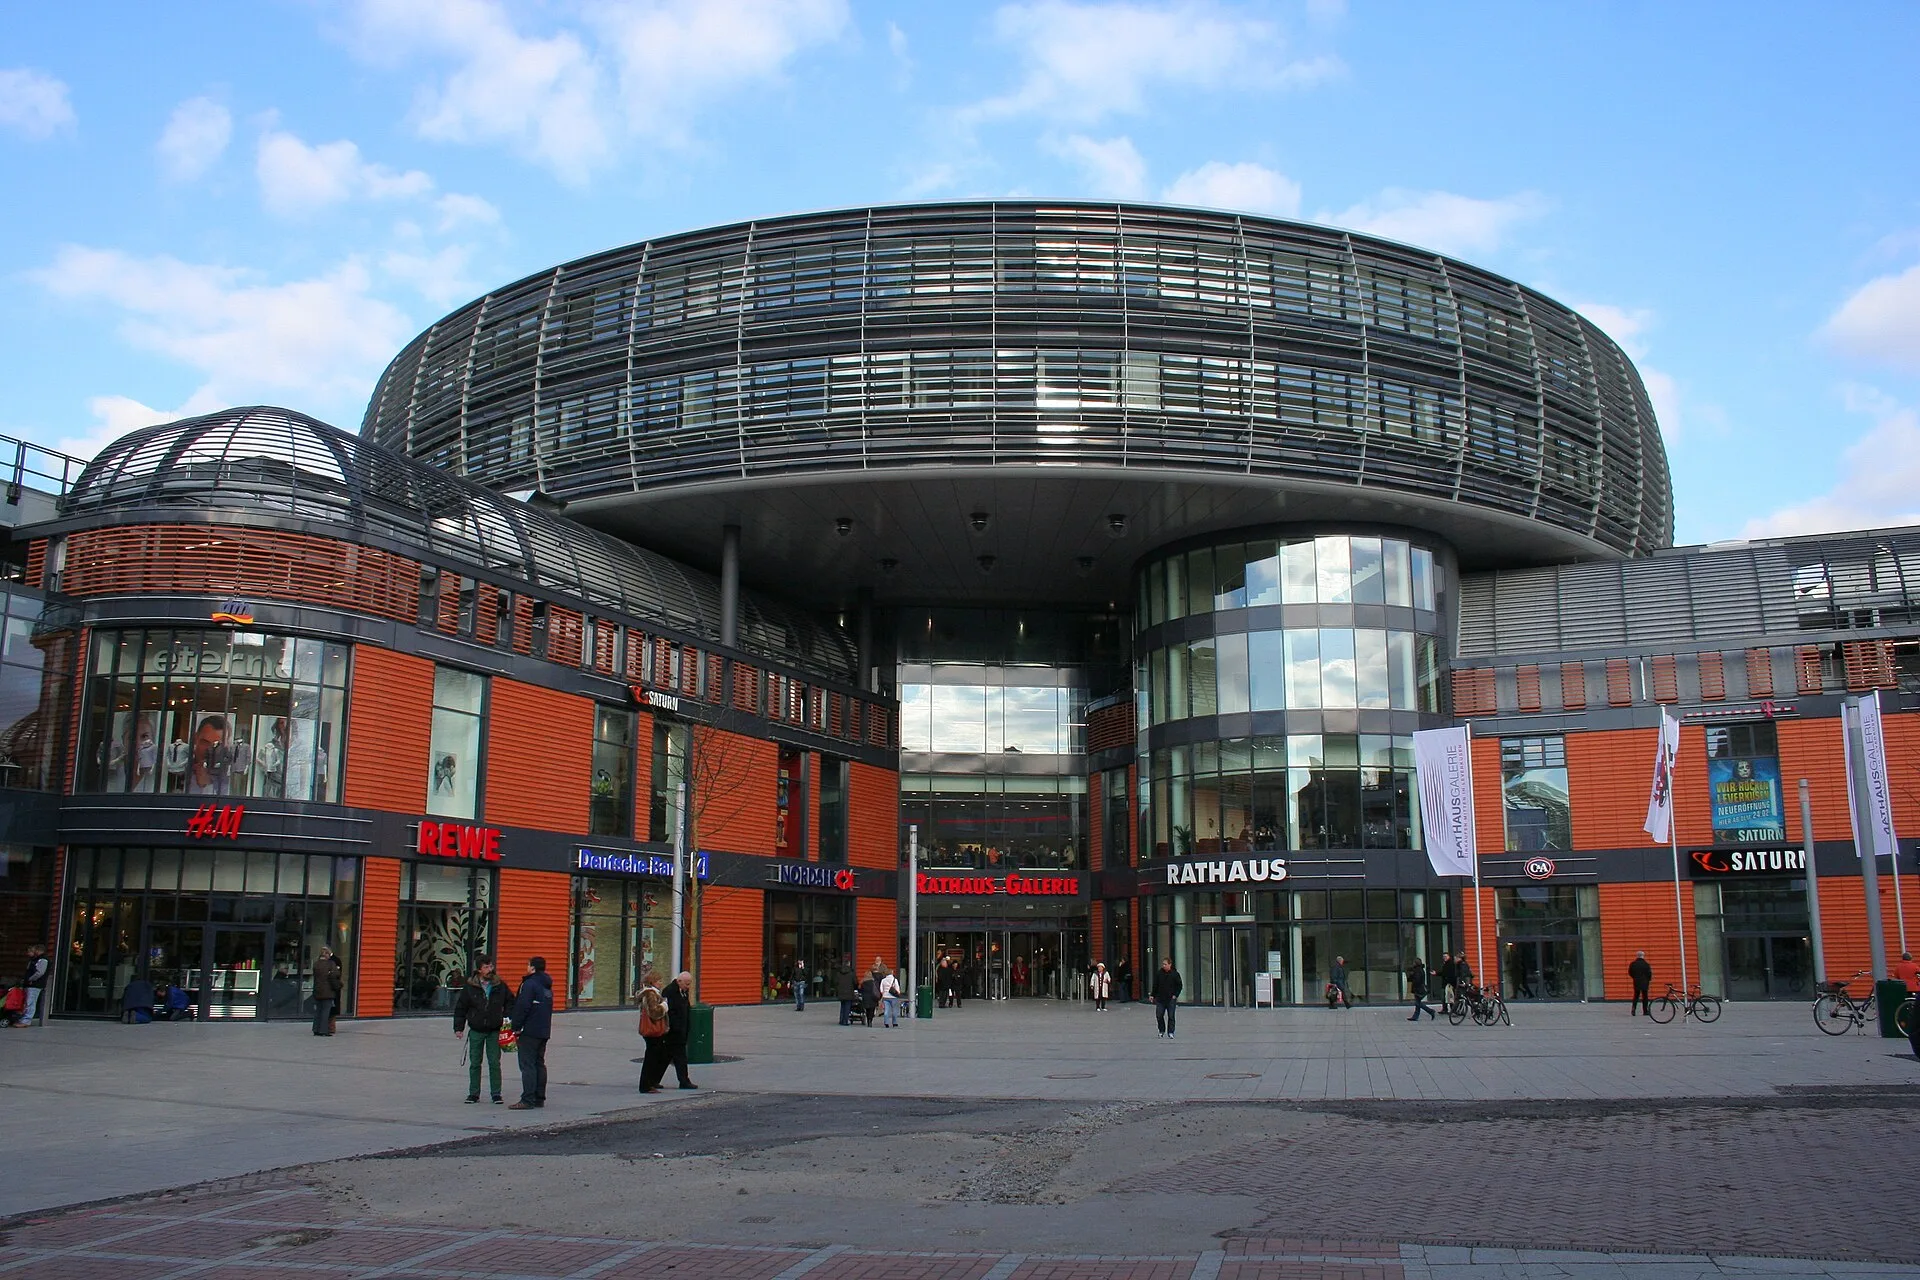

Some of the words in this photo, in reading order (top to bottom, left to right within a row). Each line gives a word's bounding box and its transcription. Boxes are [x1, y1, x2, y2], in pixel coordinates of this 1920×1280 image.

[218, 598, 251, 615] dm
[153, 646, 300, 680] eterna
[648, 690, 679, 711] SATURN
[1716, 782, 1736, 793] WIR
[1717, 791, 1770, 803] LEVERKUSEN
[1446, 745, 1465, 859] RATHAUSGALERIE
[185, 803, 245, 840] H&M
[416, 821, 501, 861] REWE
[1738, 828, 1785, 842] SATURN
[578, 849, 647, 873] Deutsche
[1167, 858, 1287, 885] RATHAUS
[1530, 862, 1549, 873] C&A
